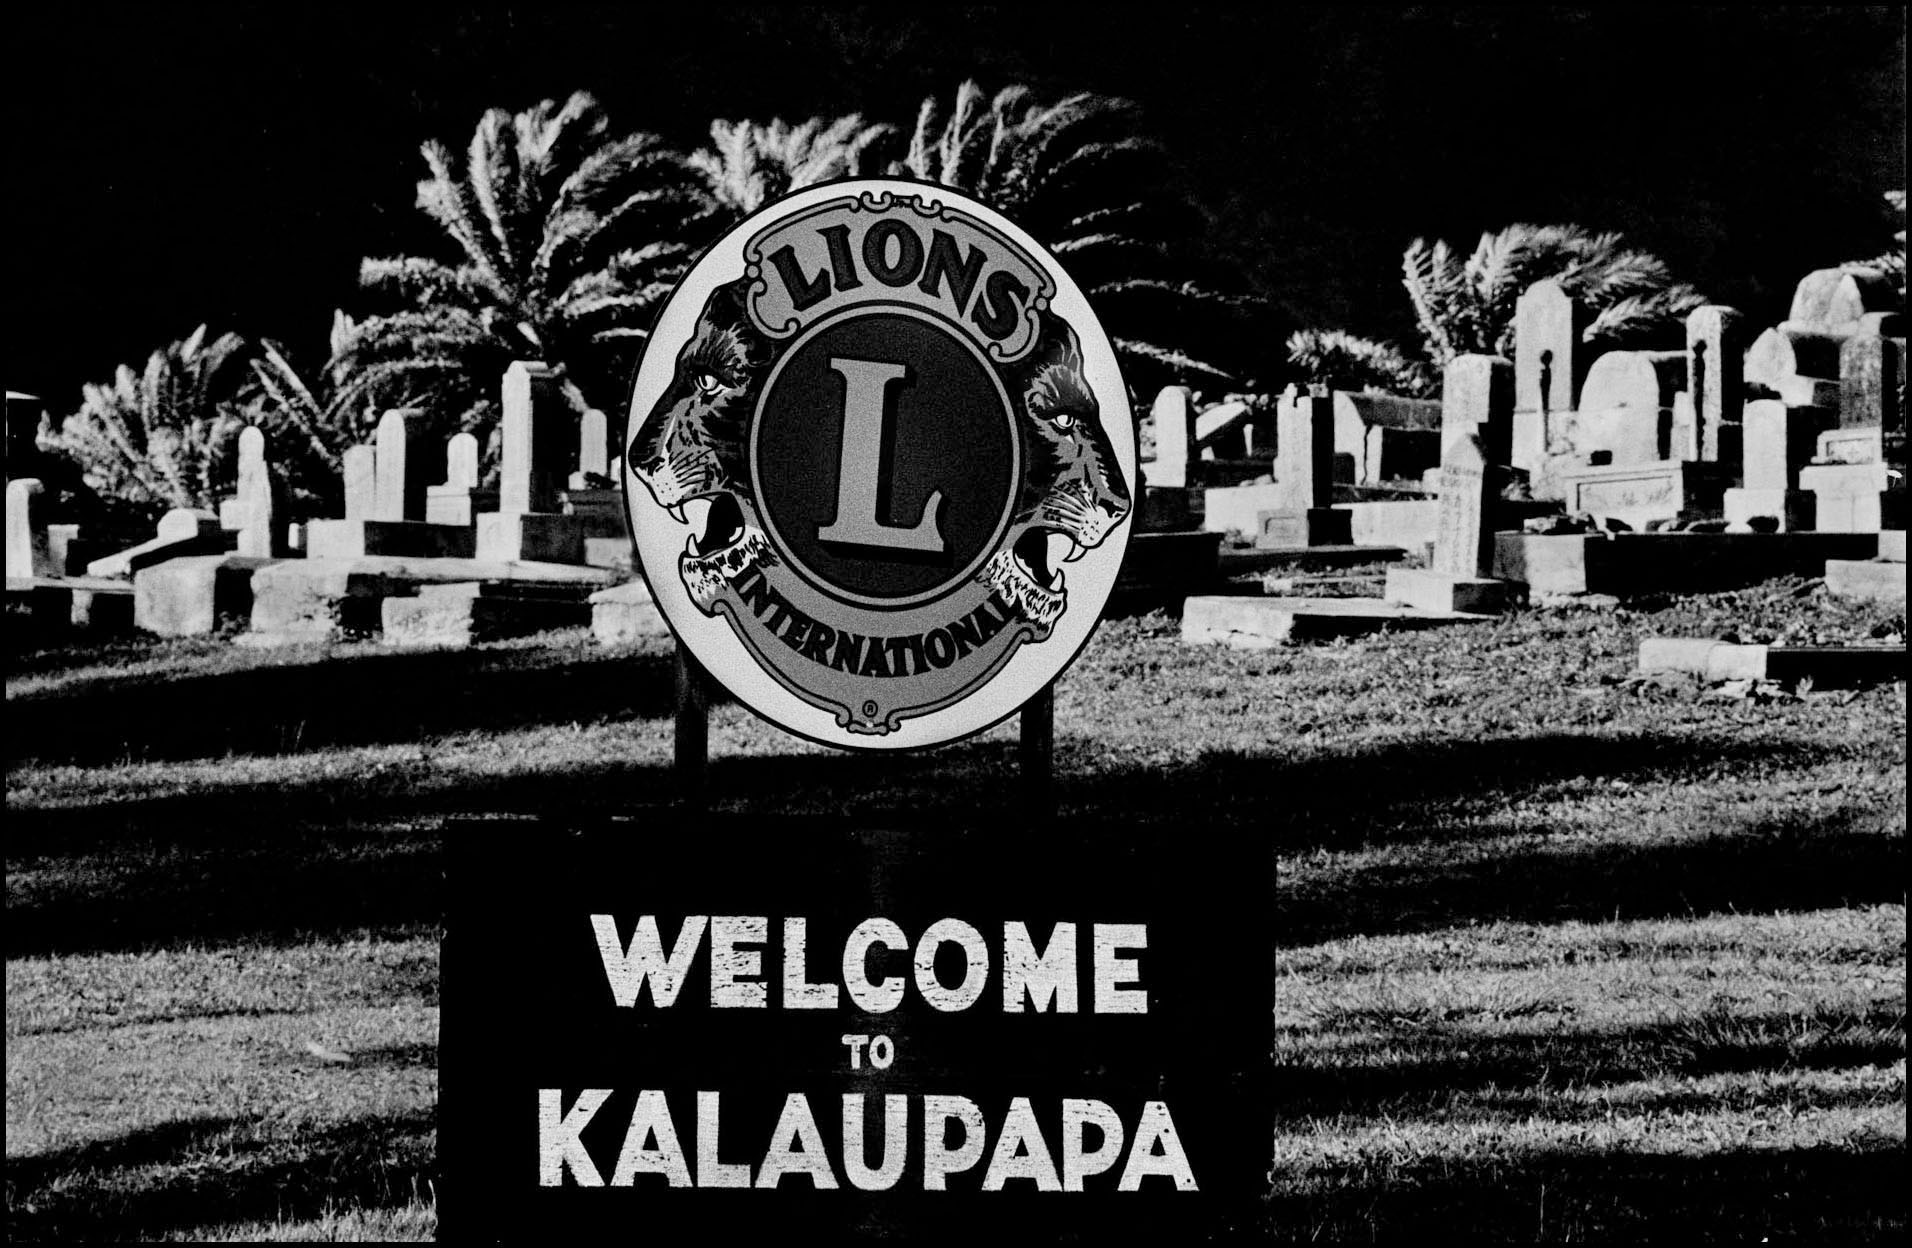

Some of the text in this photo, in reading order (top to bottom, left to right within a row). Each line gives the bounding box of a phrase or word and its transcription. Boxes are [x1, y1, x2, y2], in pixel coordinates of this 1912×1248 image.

[767, 218, 1033, 342] LIONS
[818, 357, 945, 553] L
[729, 560, 1024, 677] INTERNATIONAL
[590, 914, 1147, 1013] WELCOME
[842, 1034, 894, 1069] TO
[539, 1089, 1199, 1191] KALAUPAPA
